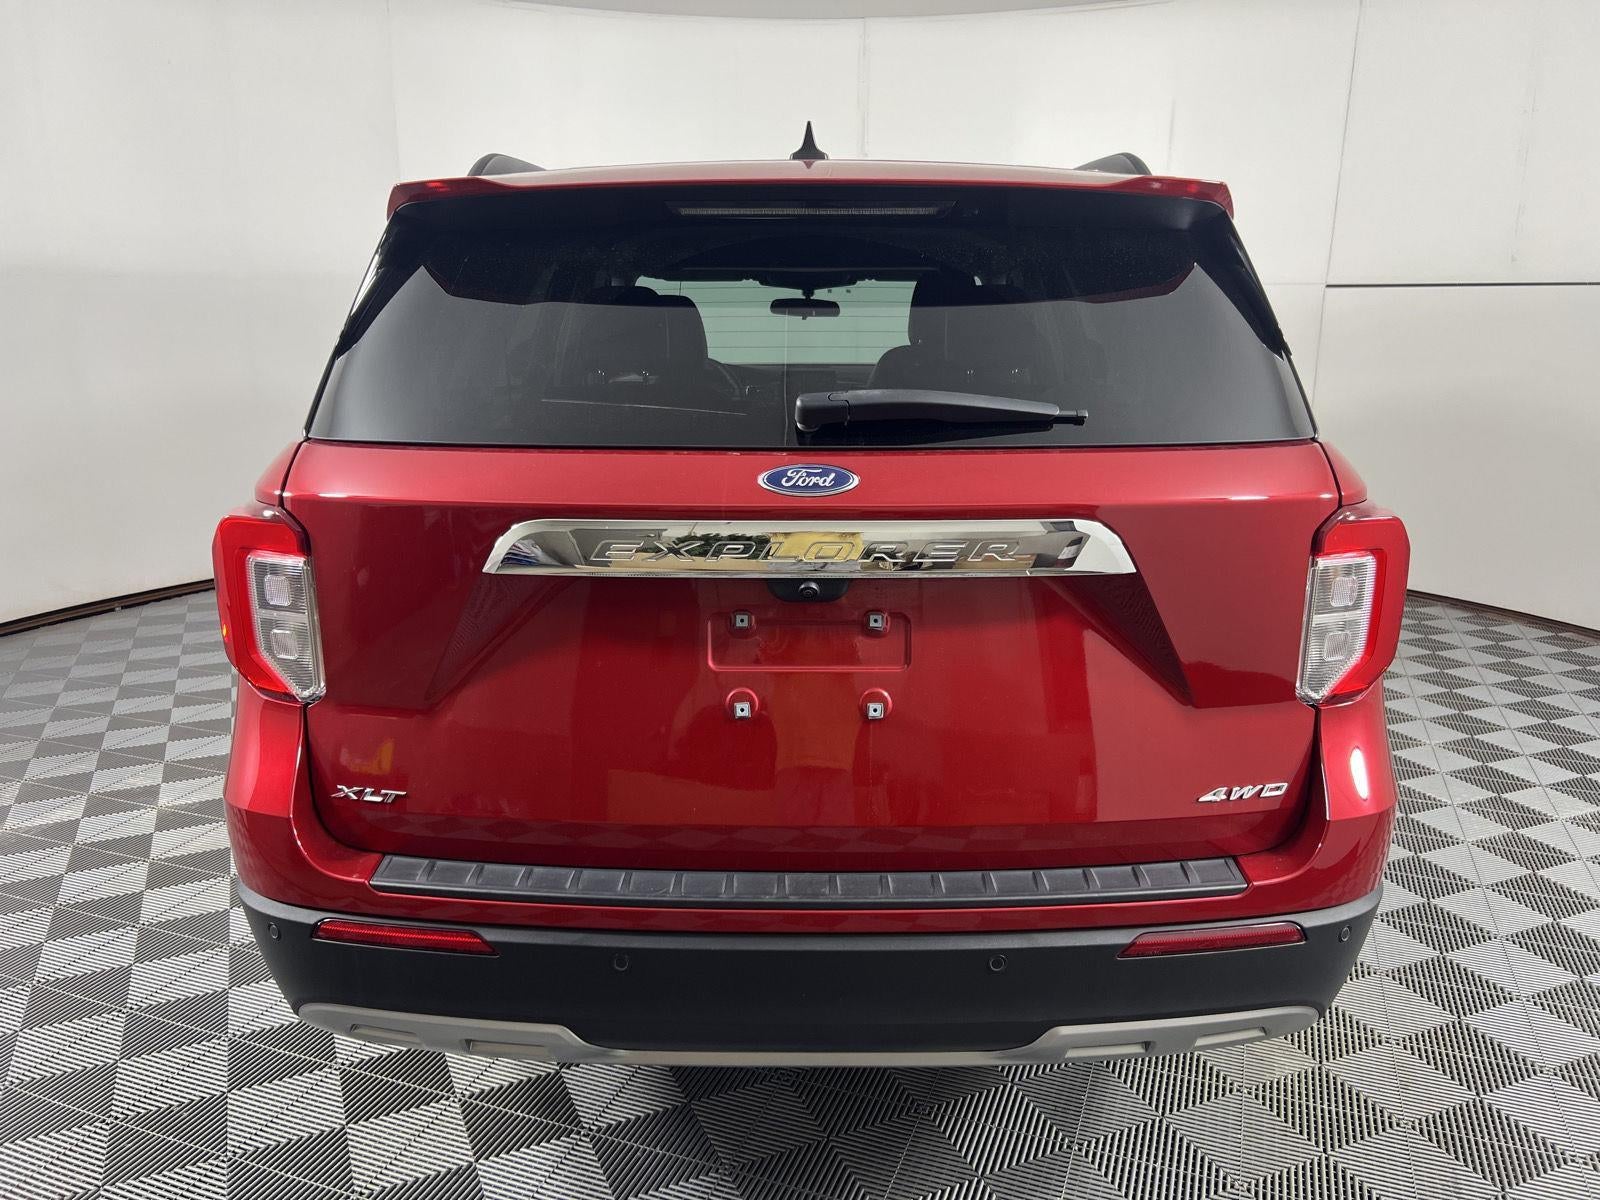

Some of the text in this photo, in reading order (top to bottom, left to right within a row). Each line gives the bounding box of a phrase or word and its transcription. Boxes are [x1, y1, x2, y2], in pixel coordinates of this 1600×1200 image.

[781, 468, 836, 487] Ford
[589, 539, 1020, 562] EXPLORER
[330, 784, 407, 804] XLT
[1197, 782, 1288, 802] 4WD
